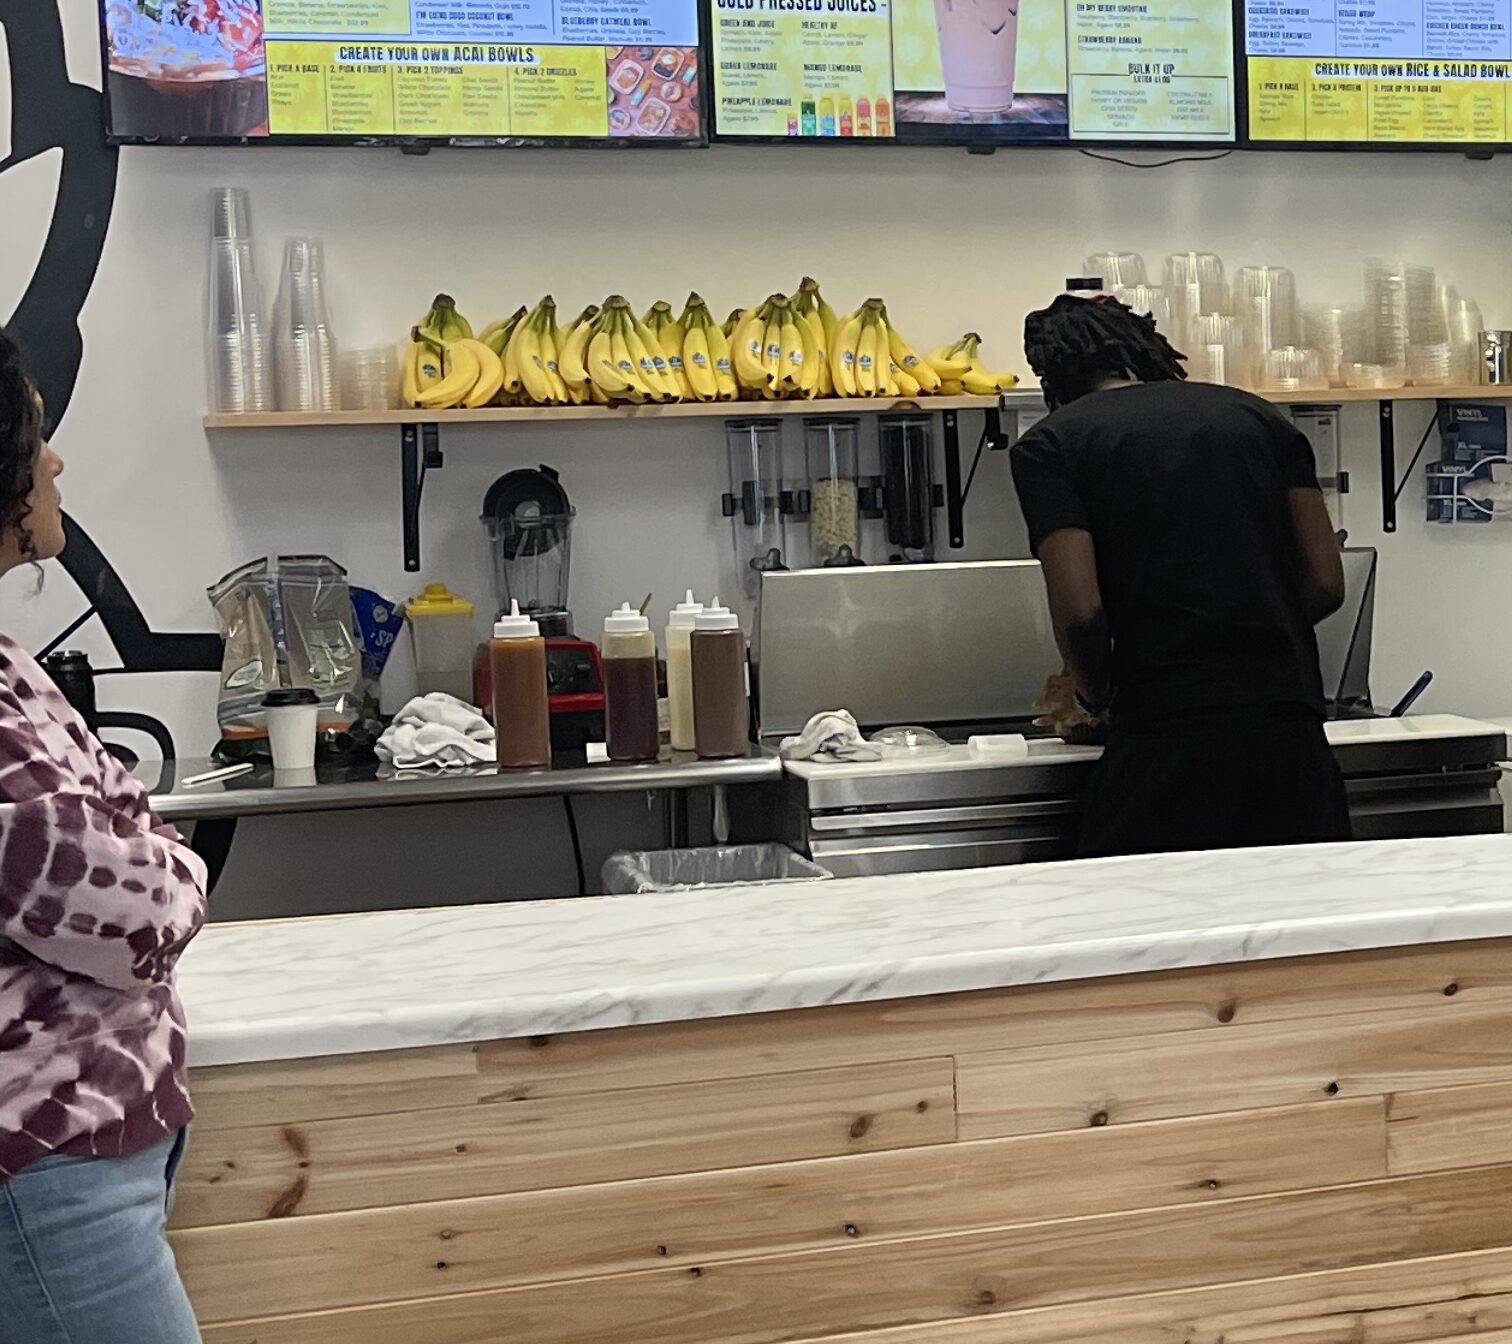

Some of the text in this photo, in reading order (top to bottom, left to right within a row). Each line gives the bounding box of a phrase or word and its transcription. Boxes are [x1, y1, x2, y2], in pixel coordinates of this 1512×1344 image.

[340, 47, 534, 62] CREATE YOUR OWN ACAI BOWLS
[1129, 64, 1174, 74] BULK IT UP
[1315, 63, 1510, 78] CREATE YOUR OWN RICE & SALAD BOWL
[1457, 409, 1482, 417] VINYL
